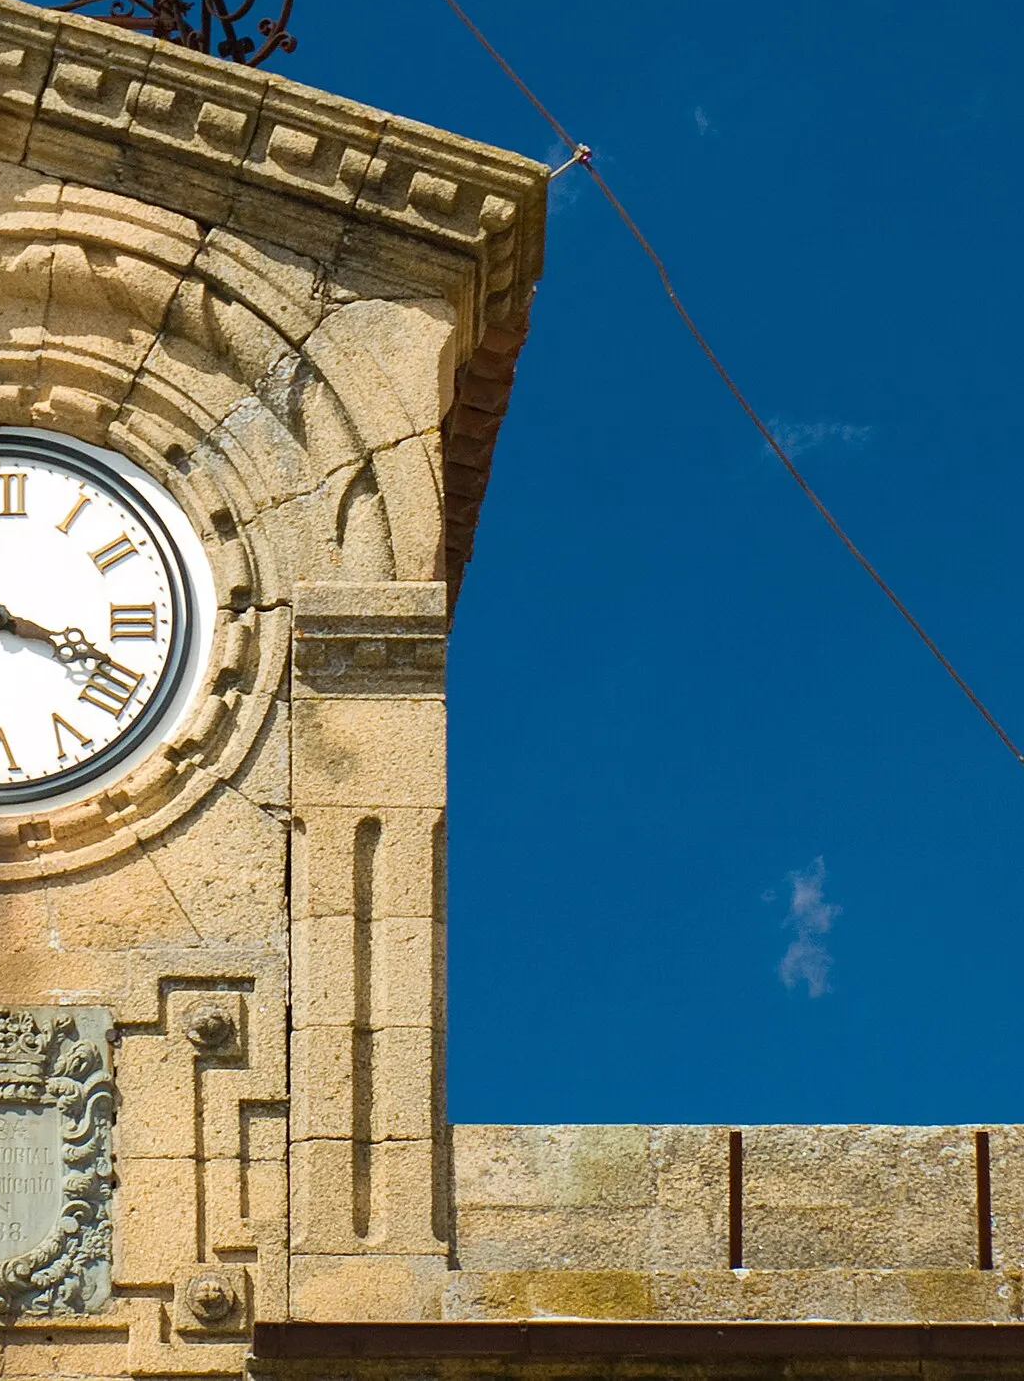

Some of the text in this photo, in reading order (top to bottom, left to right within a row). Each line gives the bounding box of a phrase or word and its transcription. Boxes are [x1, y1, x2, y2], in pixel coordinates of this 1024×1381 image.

[56, 493, 90, 532] I
[89, 531, 139, 573] II
[110, 601, 156, 640] III
[78, 657, 145, 720] IIII
[51, 712, 93, 760] V
